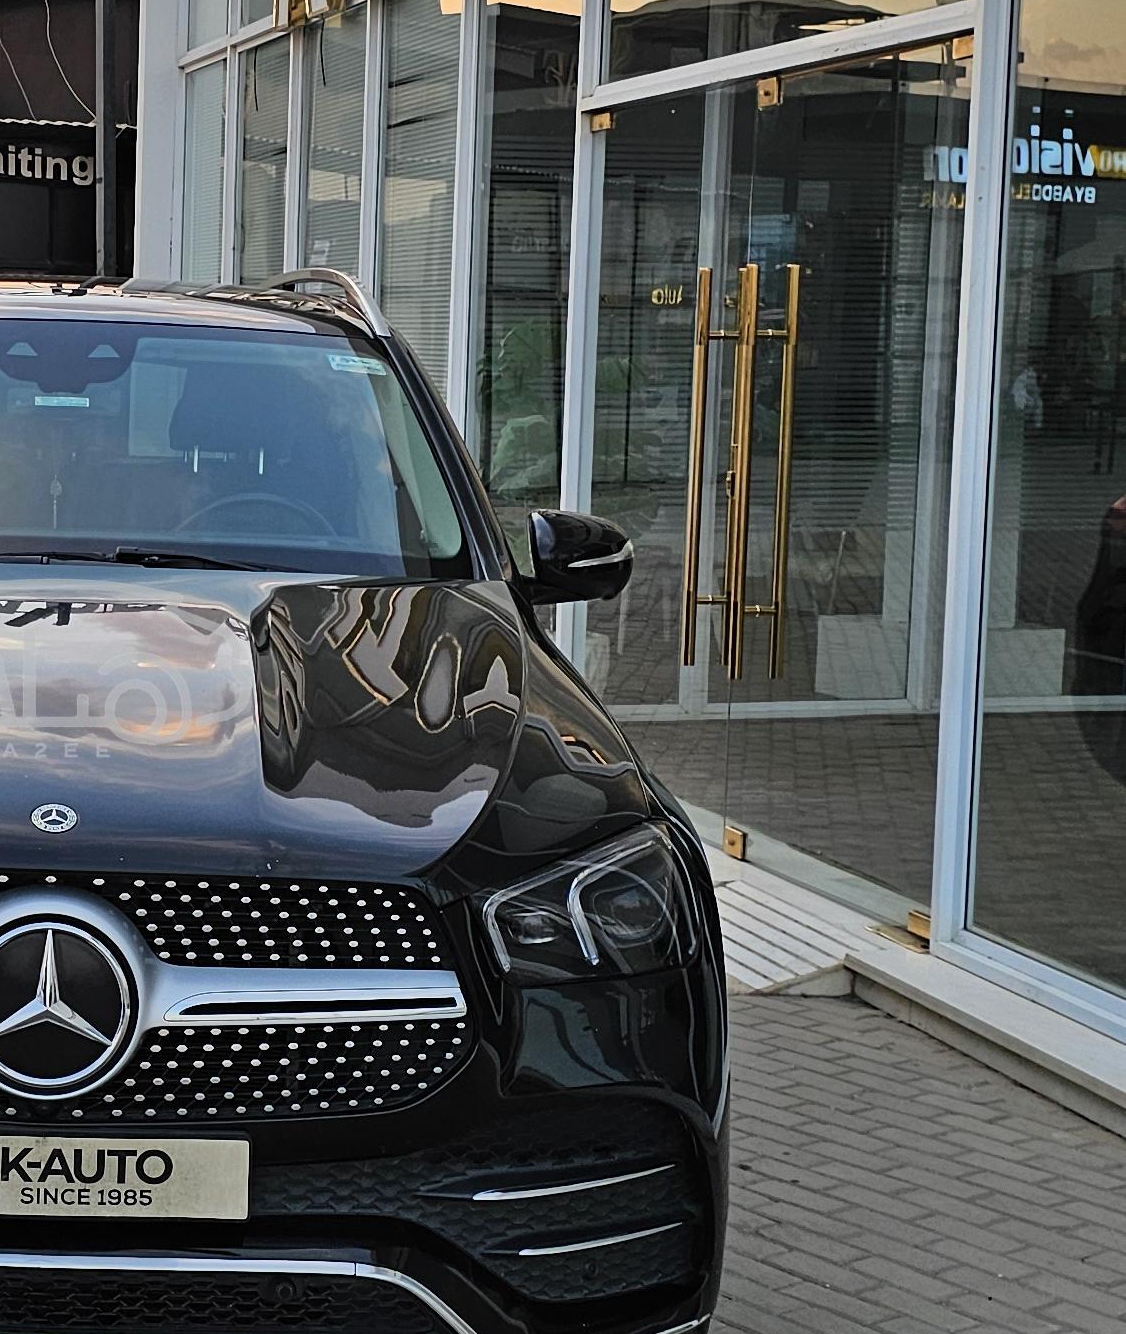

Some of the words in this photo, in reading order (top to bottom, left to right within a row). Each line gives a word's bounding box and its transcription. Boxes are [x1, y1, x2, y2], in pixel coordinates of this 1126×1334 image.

[0, 1146, 174, 1185] K-AUTO
[19, 1187, 91, 1207] SINCE
[97, 1188, 153, 1207] 1985
